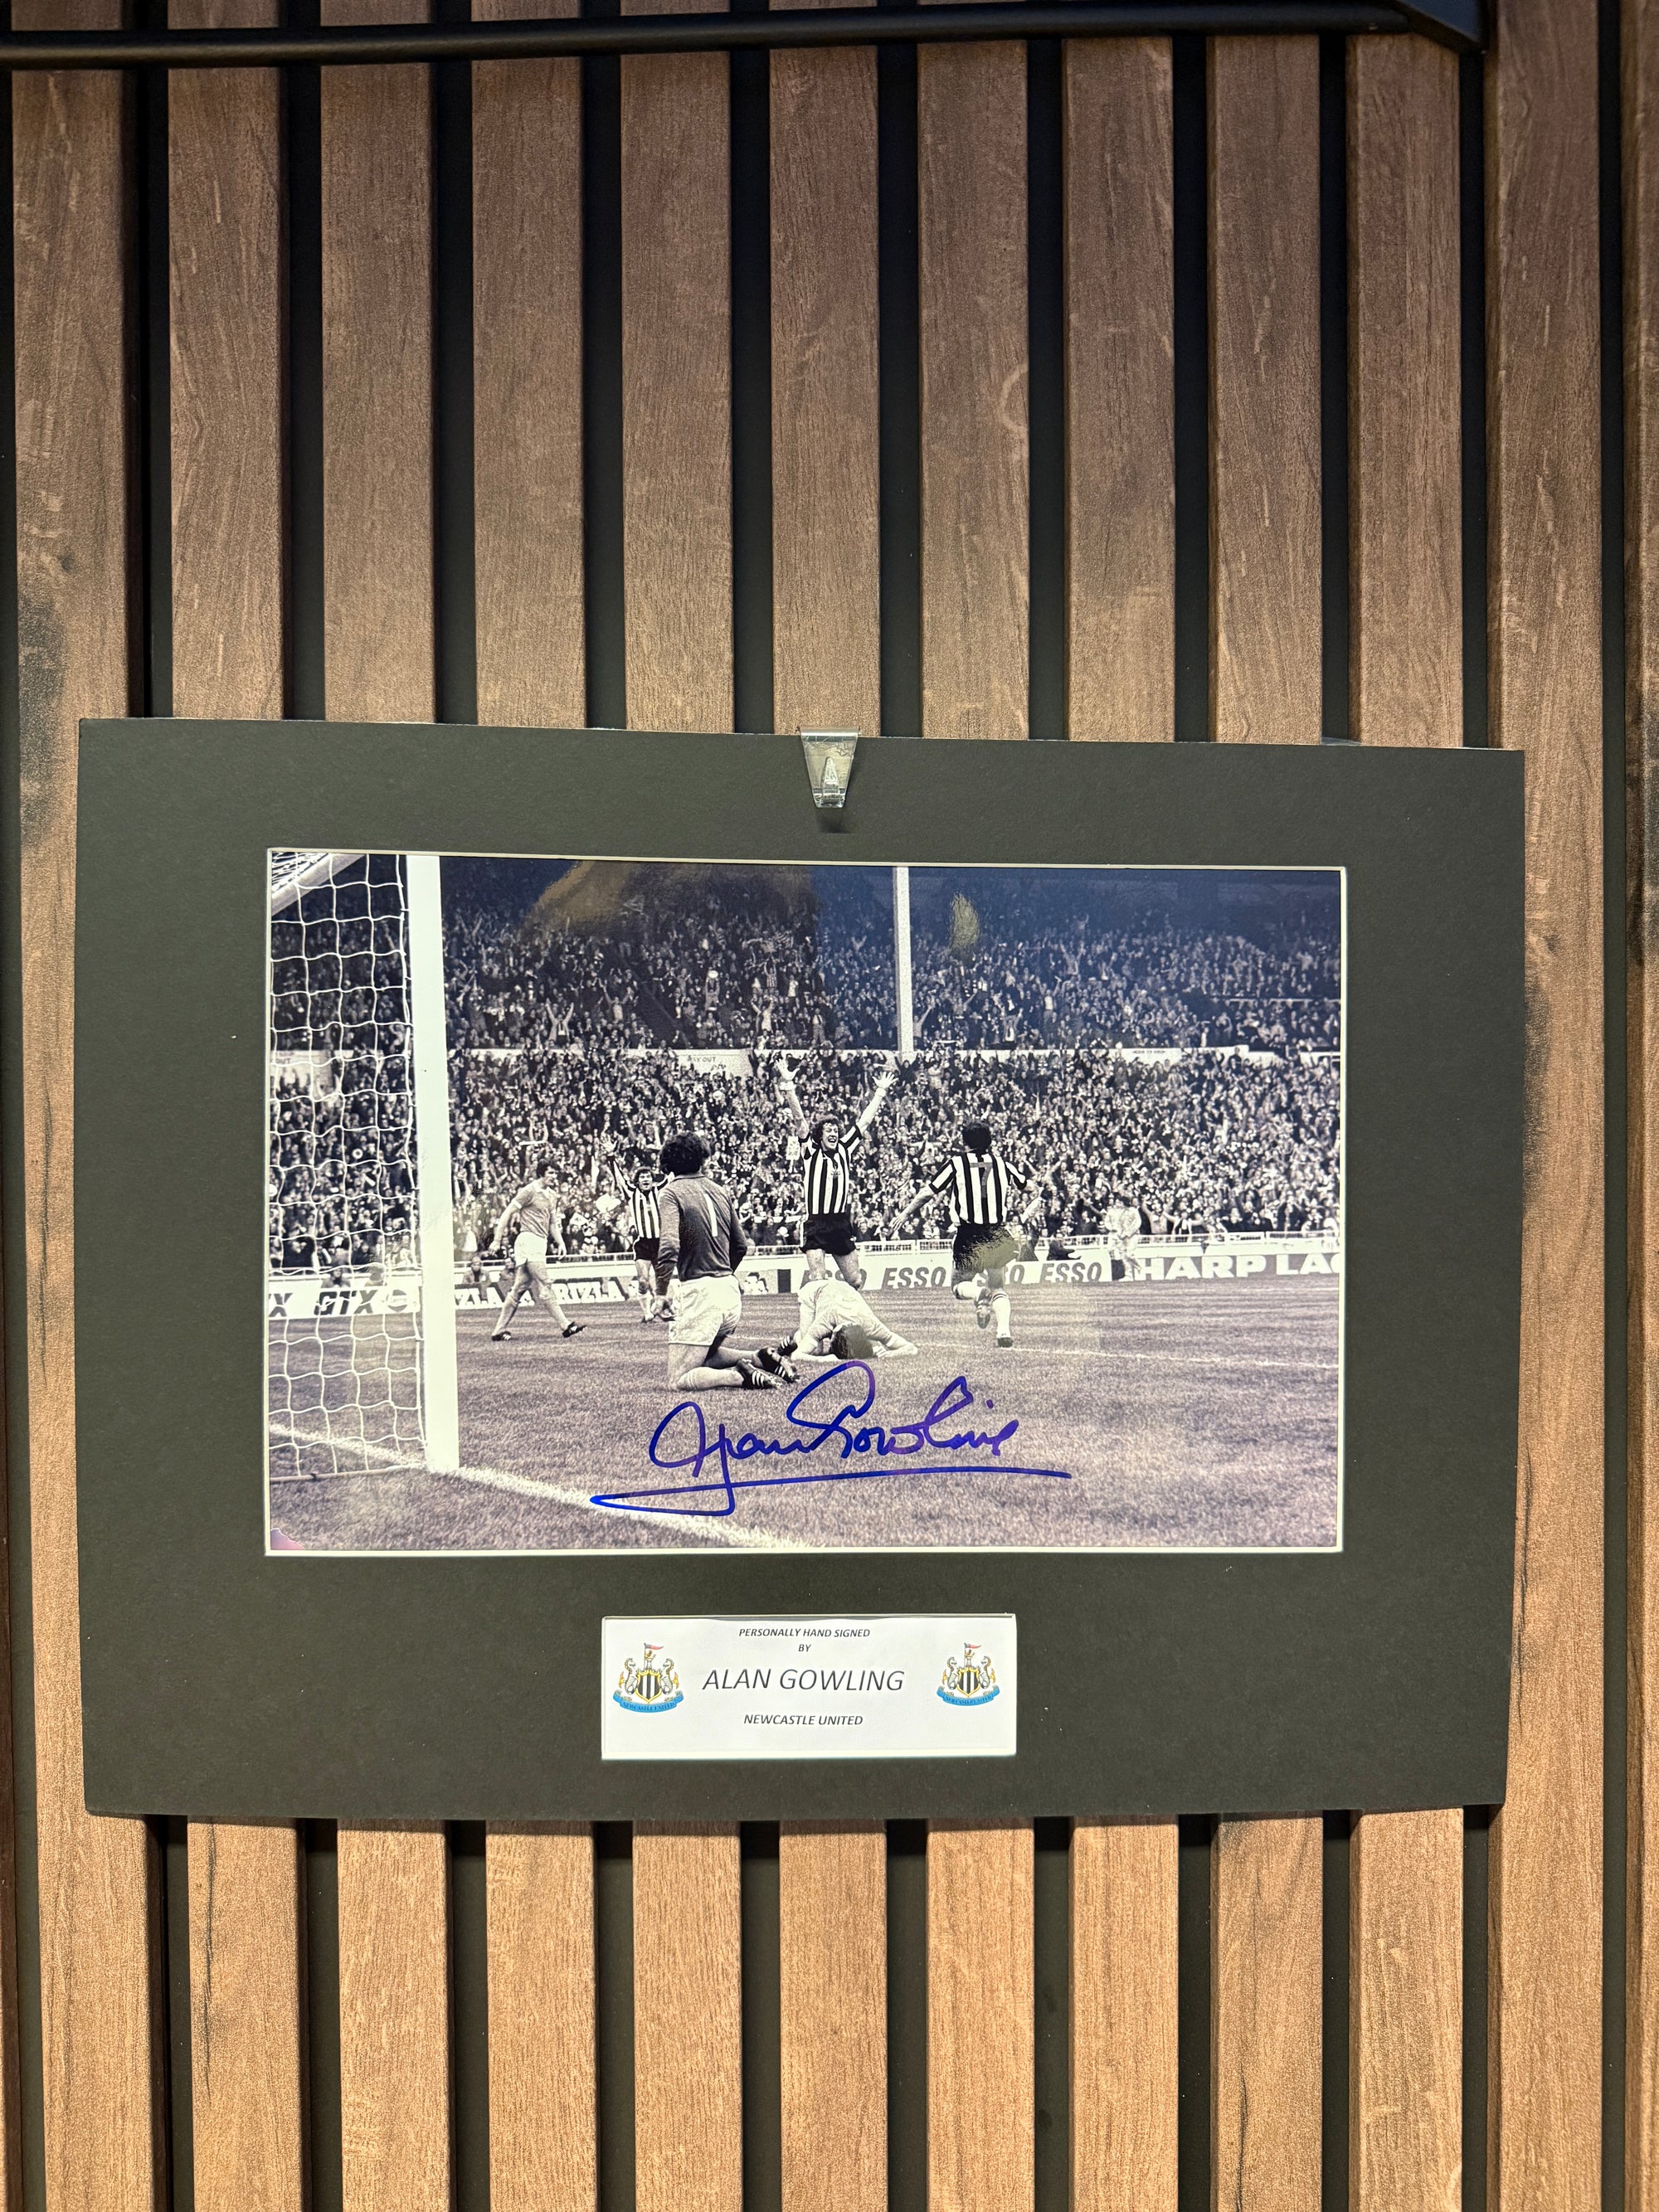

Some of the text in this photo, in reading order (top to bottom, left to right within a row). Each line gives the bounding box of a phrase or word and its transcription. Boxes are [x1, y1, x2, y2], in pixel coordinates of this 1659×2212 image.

[970, 1161, 993, 1198] 7
[882, 1266, 946, 1289] ESSO
[1040, 1262, 1102, 1283] ESSO
[1134, 1255, 1266, 1281] HARP
[314, 1290, 379, 1316] GTX
[555, 1281, 626, 1305] RIZLA
[739, 1628, 870, 1638] PERSONALLY HAND SIGNED
[798, 1644, 811, 1652] BY
[702, 1668, 905, 1691] ALAN GOWLING
[743, 1714, 864, 1726] NEWCASTLE UNITED
